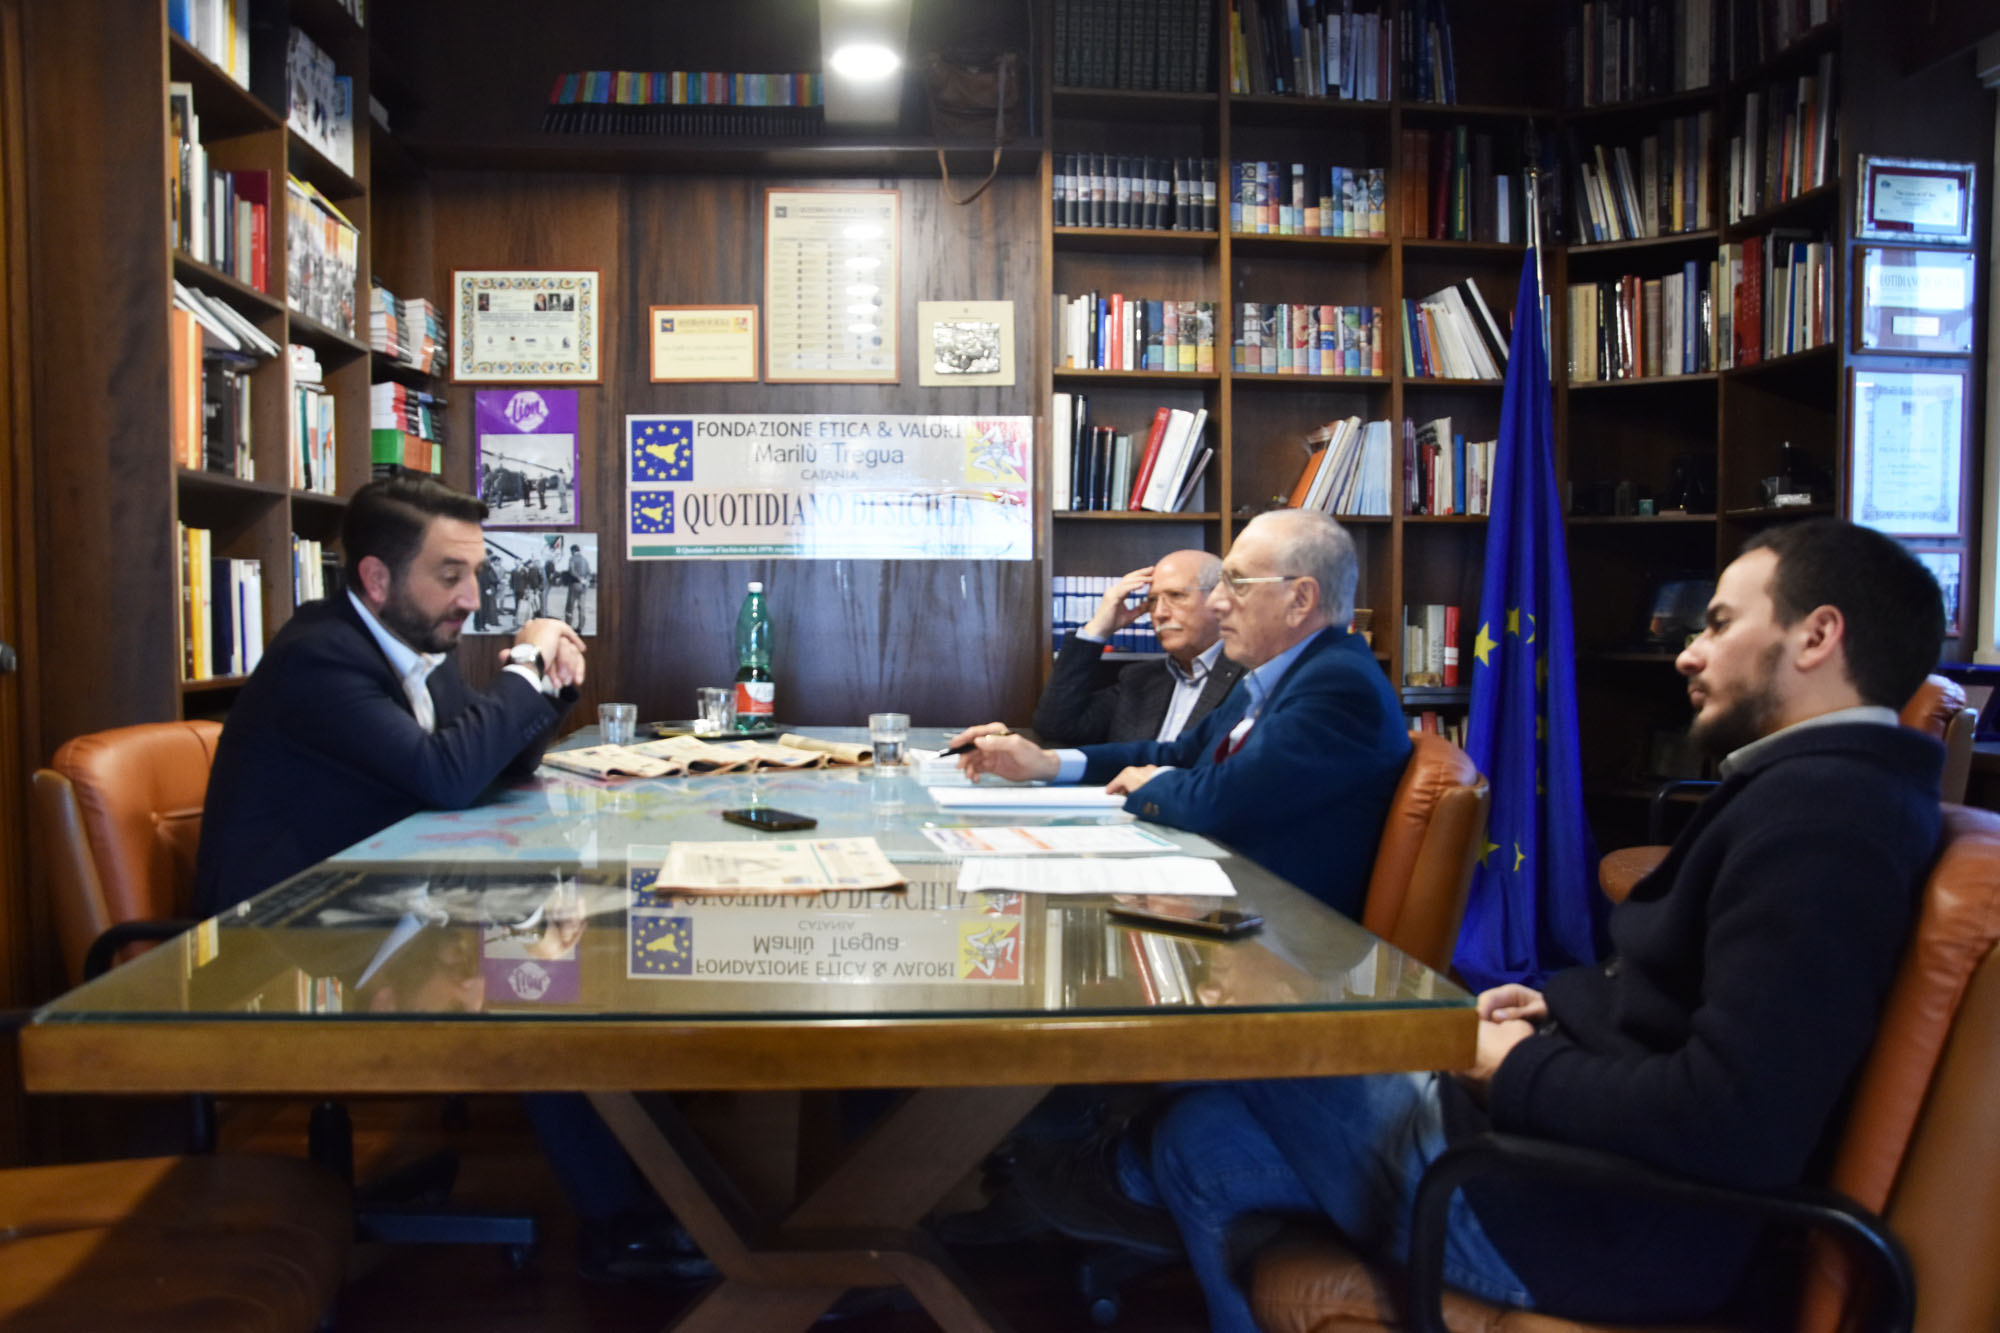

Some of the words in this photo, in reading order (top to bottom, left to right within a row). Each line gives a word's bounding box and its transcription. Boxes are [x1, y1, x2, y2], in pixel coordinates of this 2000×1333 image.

[697, 421, 812, 438] FONDAZIONE
[820, 420, 870, 438] ETICA
[877, 421, 892, 437] &
[899, 421, 962, 439] VALORI
[754, 443, 817, 464] Marilù
[832, 442, 905, 468] Tregua
[801, 469, 859, 480] CATANIA
[683, 492, 844, 535] QUOTIDIANO
